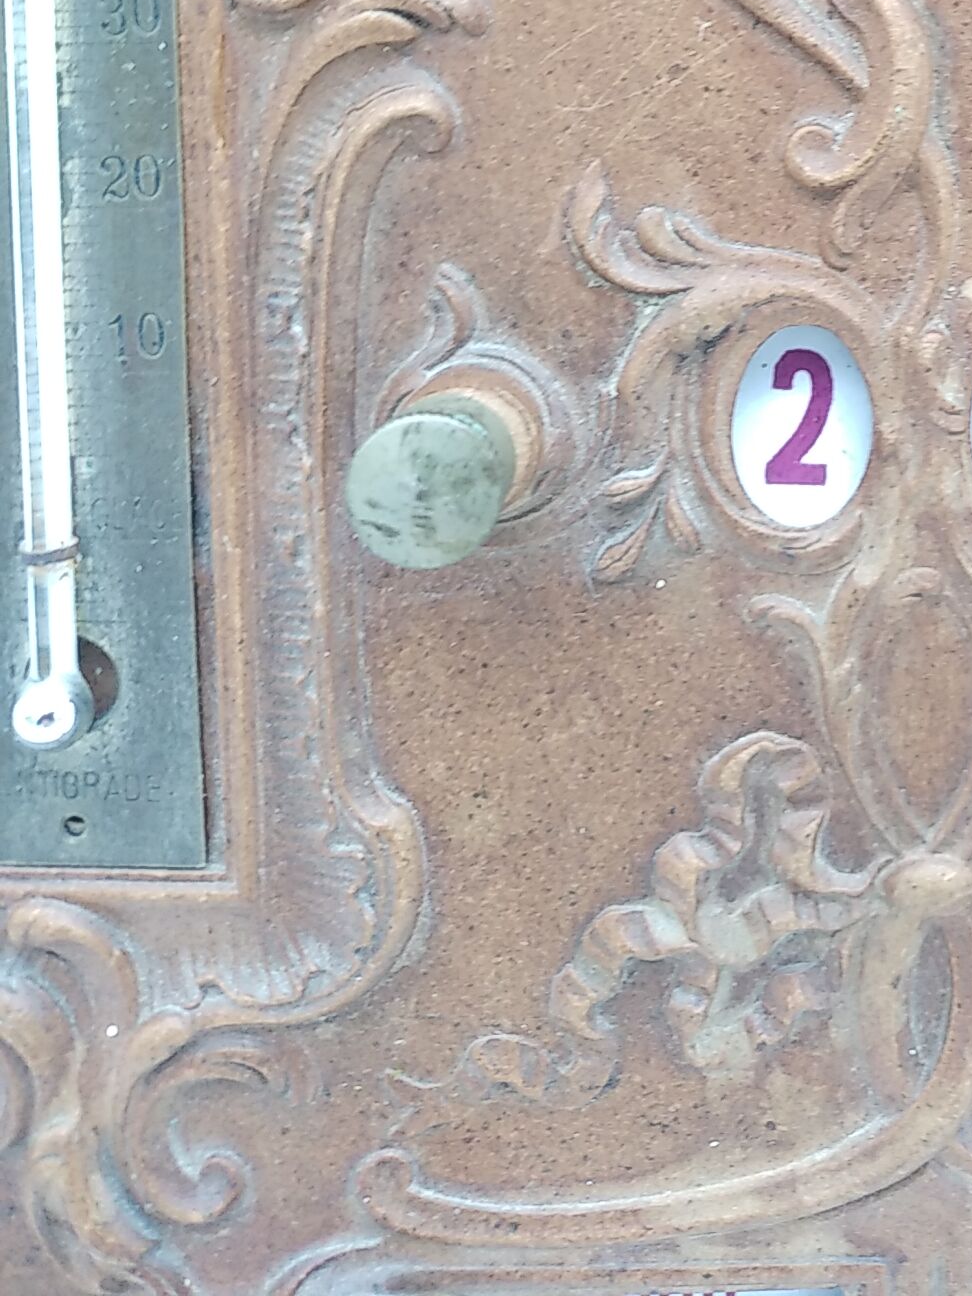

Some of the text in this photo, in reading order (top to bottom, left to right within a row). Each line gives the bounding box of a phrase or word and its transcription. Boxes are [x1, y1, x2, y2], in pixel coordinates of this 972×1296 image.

[101, 154, 161, 199] 20
[108, 312, 166, 363] 10
[765, 347, 833, 486] 2
